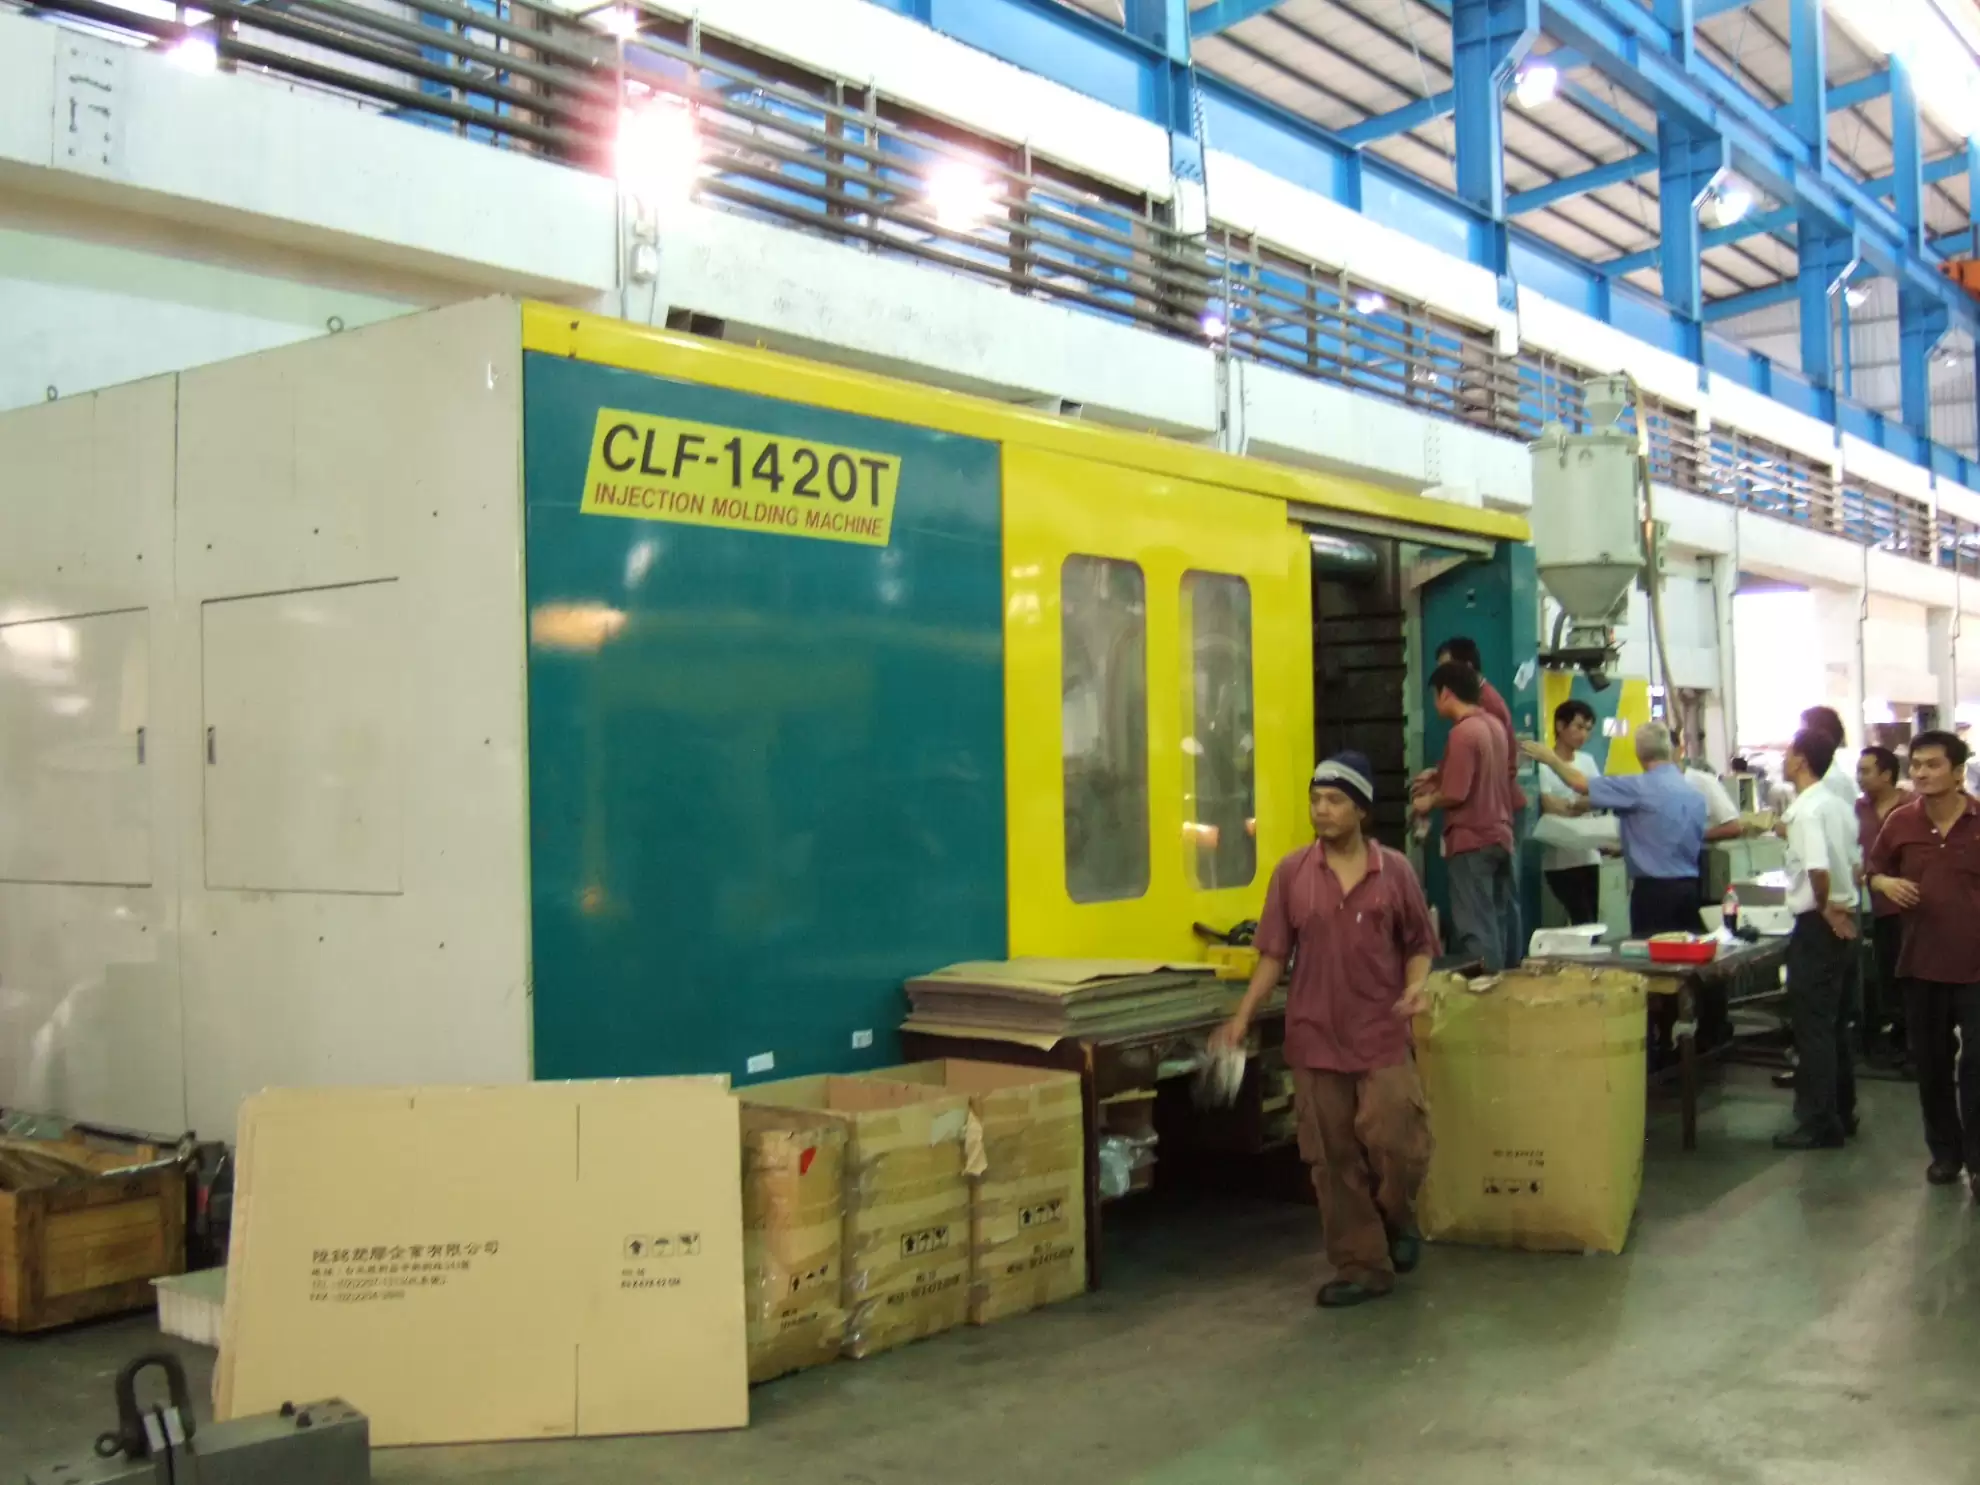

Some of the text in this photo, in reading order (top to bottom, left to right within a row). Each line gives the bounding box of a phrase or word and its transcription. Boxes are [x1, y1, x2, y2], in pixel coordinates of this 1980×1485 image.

[601, 423, 891, 508] CLF-1420T
[594, 482, 883, 537] INJECTION MOLDING MACHINE
